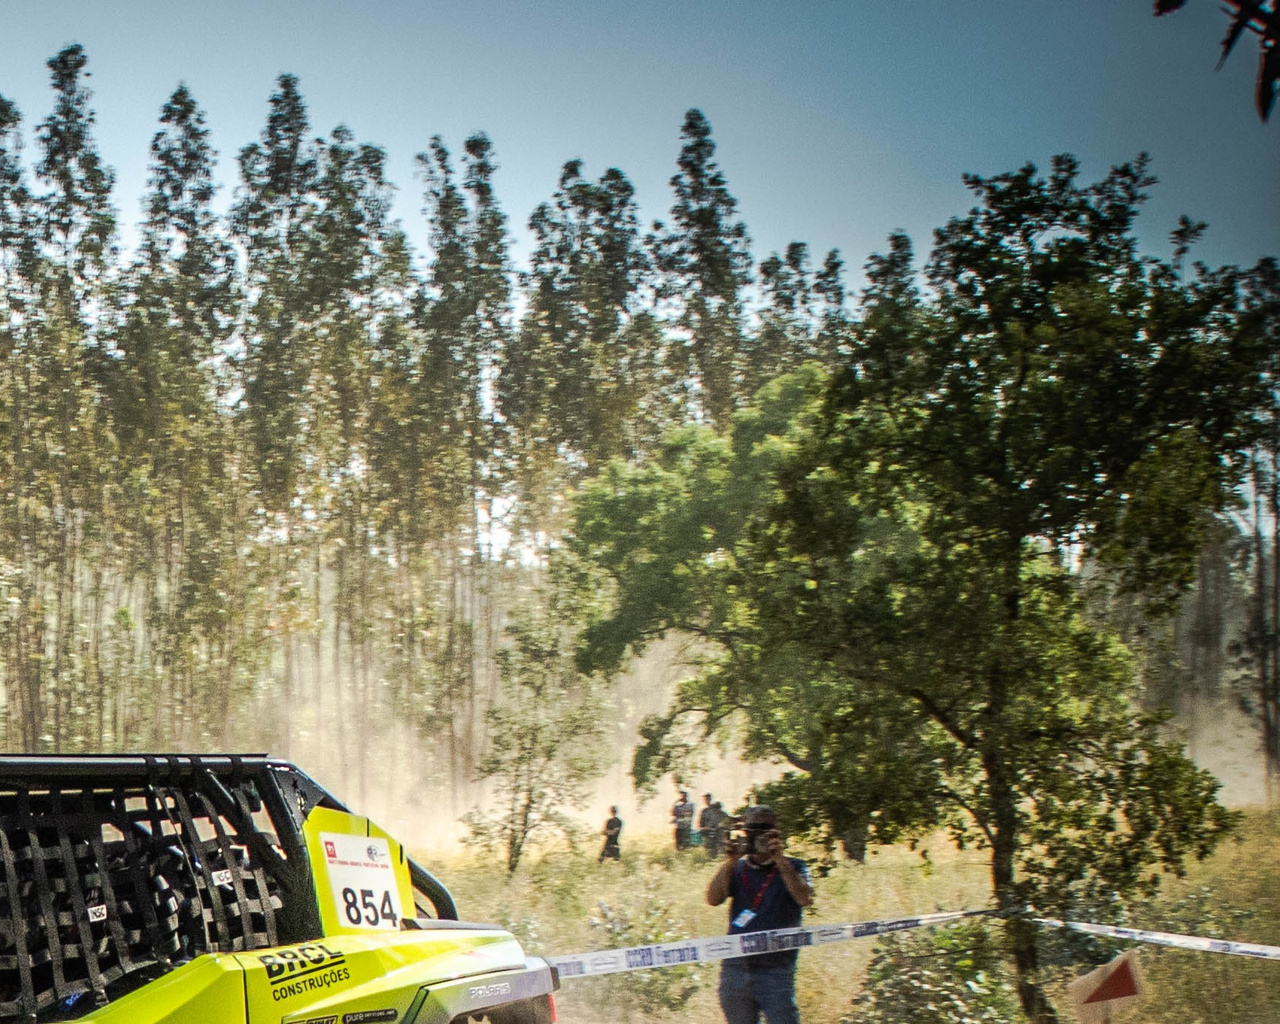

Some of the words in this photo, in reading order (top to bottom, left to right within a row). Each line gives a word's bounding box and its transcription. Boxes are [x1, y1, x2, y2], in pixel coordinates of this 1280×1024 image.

[342, 887, 398, 927] 854
[258, 943, 345, 979] BRCL
[272, 967, 351, 1002] CONSTRUÇÕES
